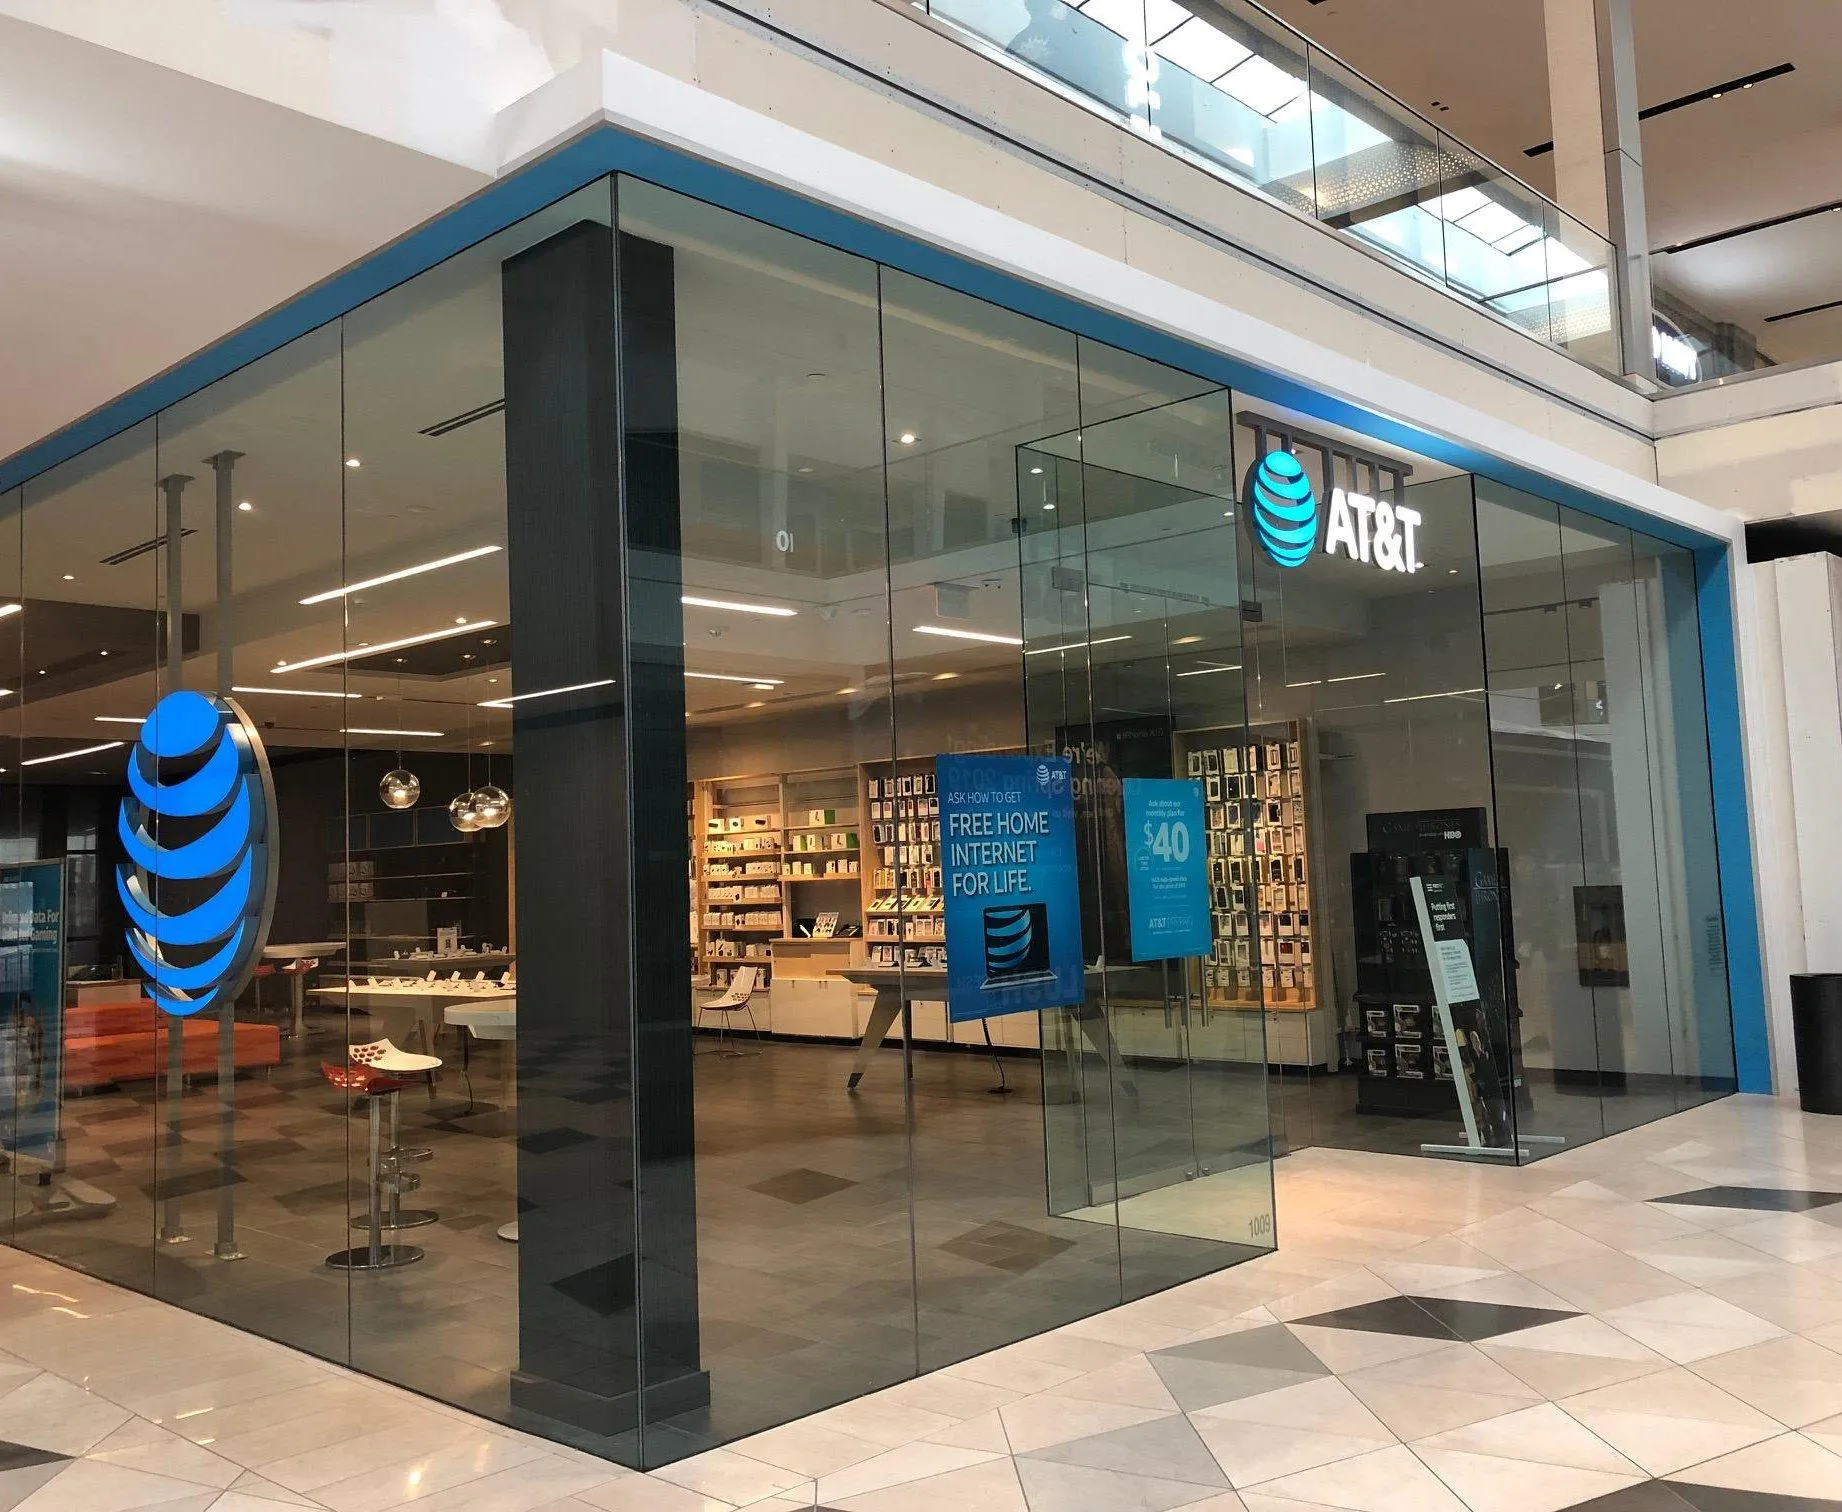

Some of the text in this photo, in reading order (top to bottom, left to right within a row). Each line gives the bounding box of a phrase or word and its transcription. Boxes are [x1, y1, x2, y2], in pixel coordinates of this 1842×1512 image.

[1325, 488, 1422, 574] AT&T
[1051, 770, 1067, 780] AT&T
[947, 791, 1021, 804] ASK HOW TO GET
[949, 812, 994, 837] FREE
[997, 811, 1050, 835] HOME
[1443, 830, 1462, 840] HBO
[951, 840, 1037, 867] INTERNET
[1144, 820, 1190, 863] $40
[952, 869, 1032, 897] FOR LIFE.
[1149, 917, 1165, 928] AT&T
[1249, 1214, 1271, 1238] 1009
